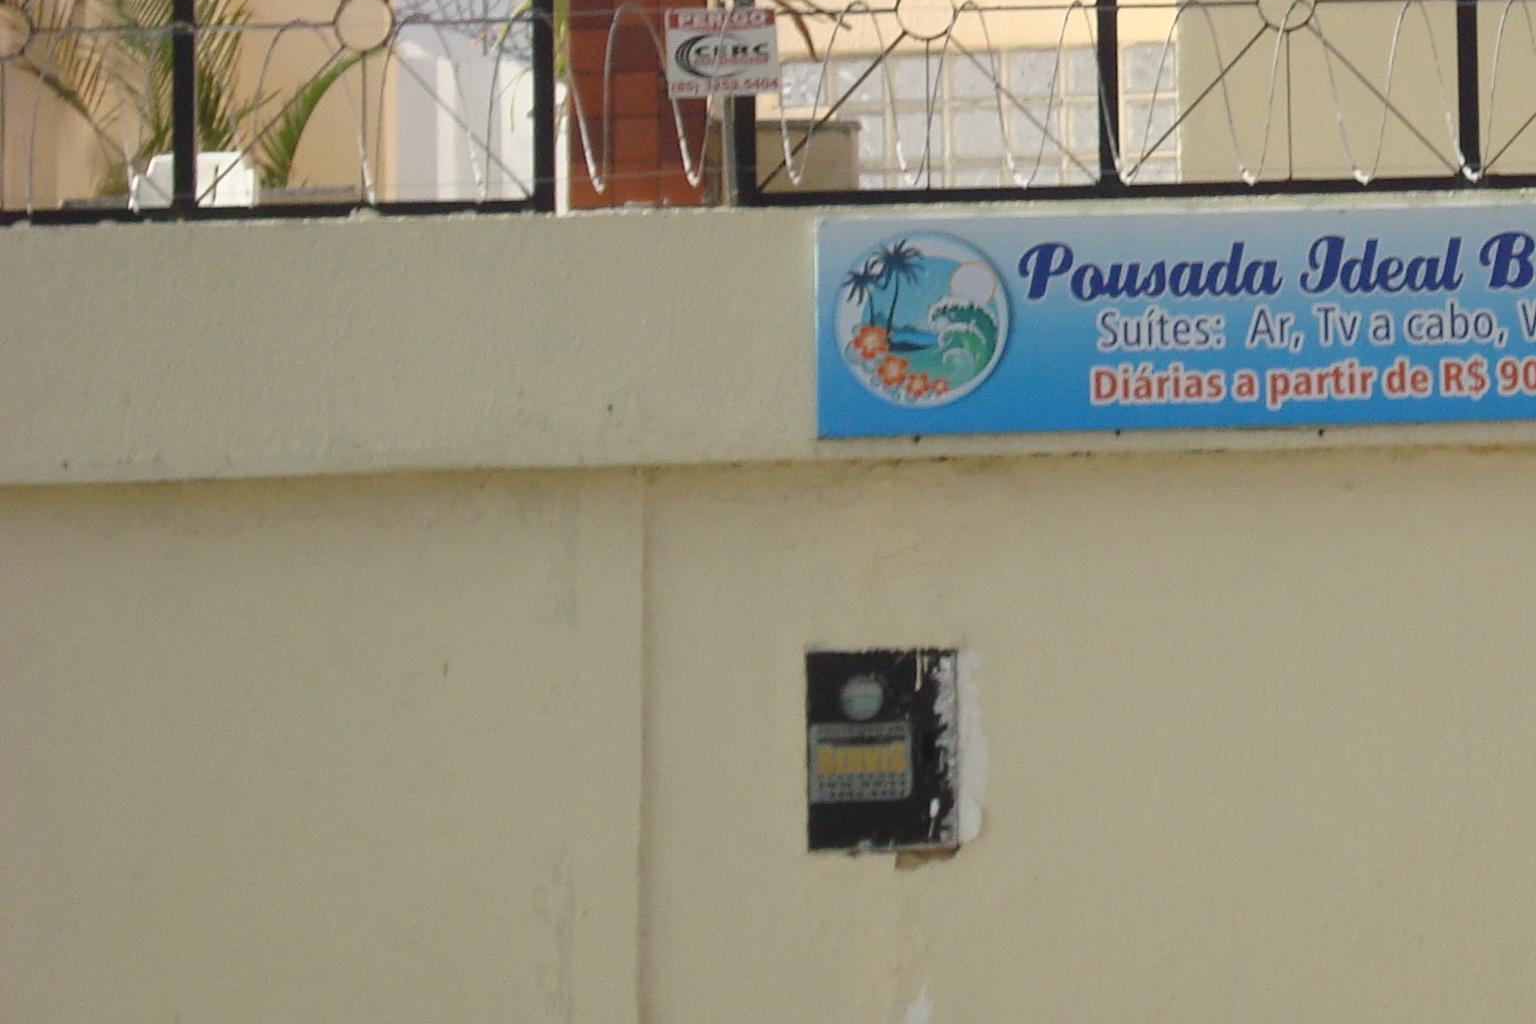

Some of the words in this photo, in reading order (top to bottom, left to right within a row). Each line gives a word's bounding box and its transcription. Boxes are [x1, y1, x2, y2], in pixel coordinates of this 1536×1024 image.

[679, 12, 767, 29] PERIGO
[1017, 241, 1283, 301] Pousada
[1299, 234, 1464, 294] Ideal
[1099, 307, 1224, 349] Suítes:
[1249, 308, 1301, 349] Ar,
[1316, 306, 1359, 343] Tv
[1371, 313, 1392, 342] a
[1406, 301, 1507, 345] cabo,
[1093, 365, 1222, 402] Diárias
[1235, 373, 1256, 398] a
[1269, 359, 1375, 407] partir
[1384, 360, 1430, 395] de
[1442, 356, 1488, 396] R$
